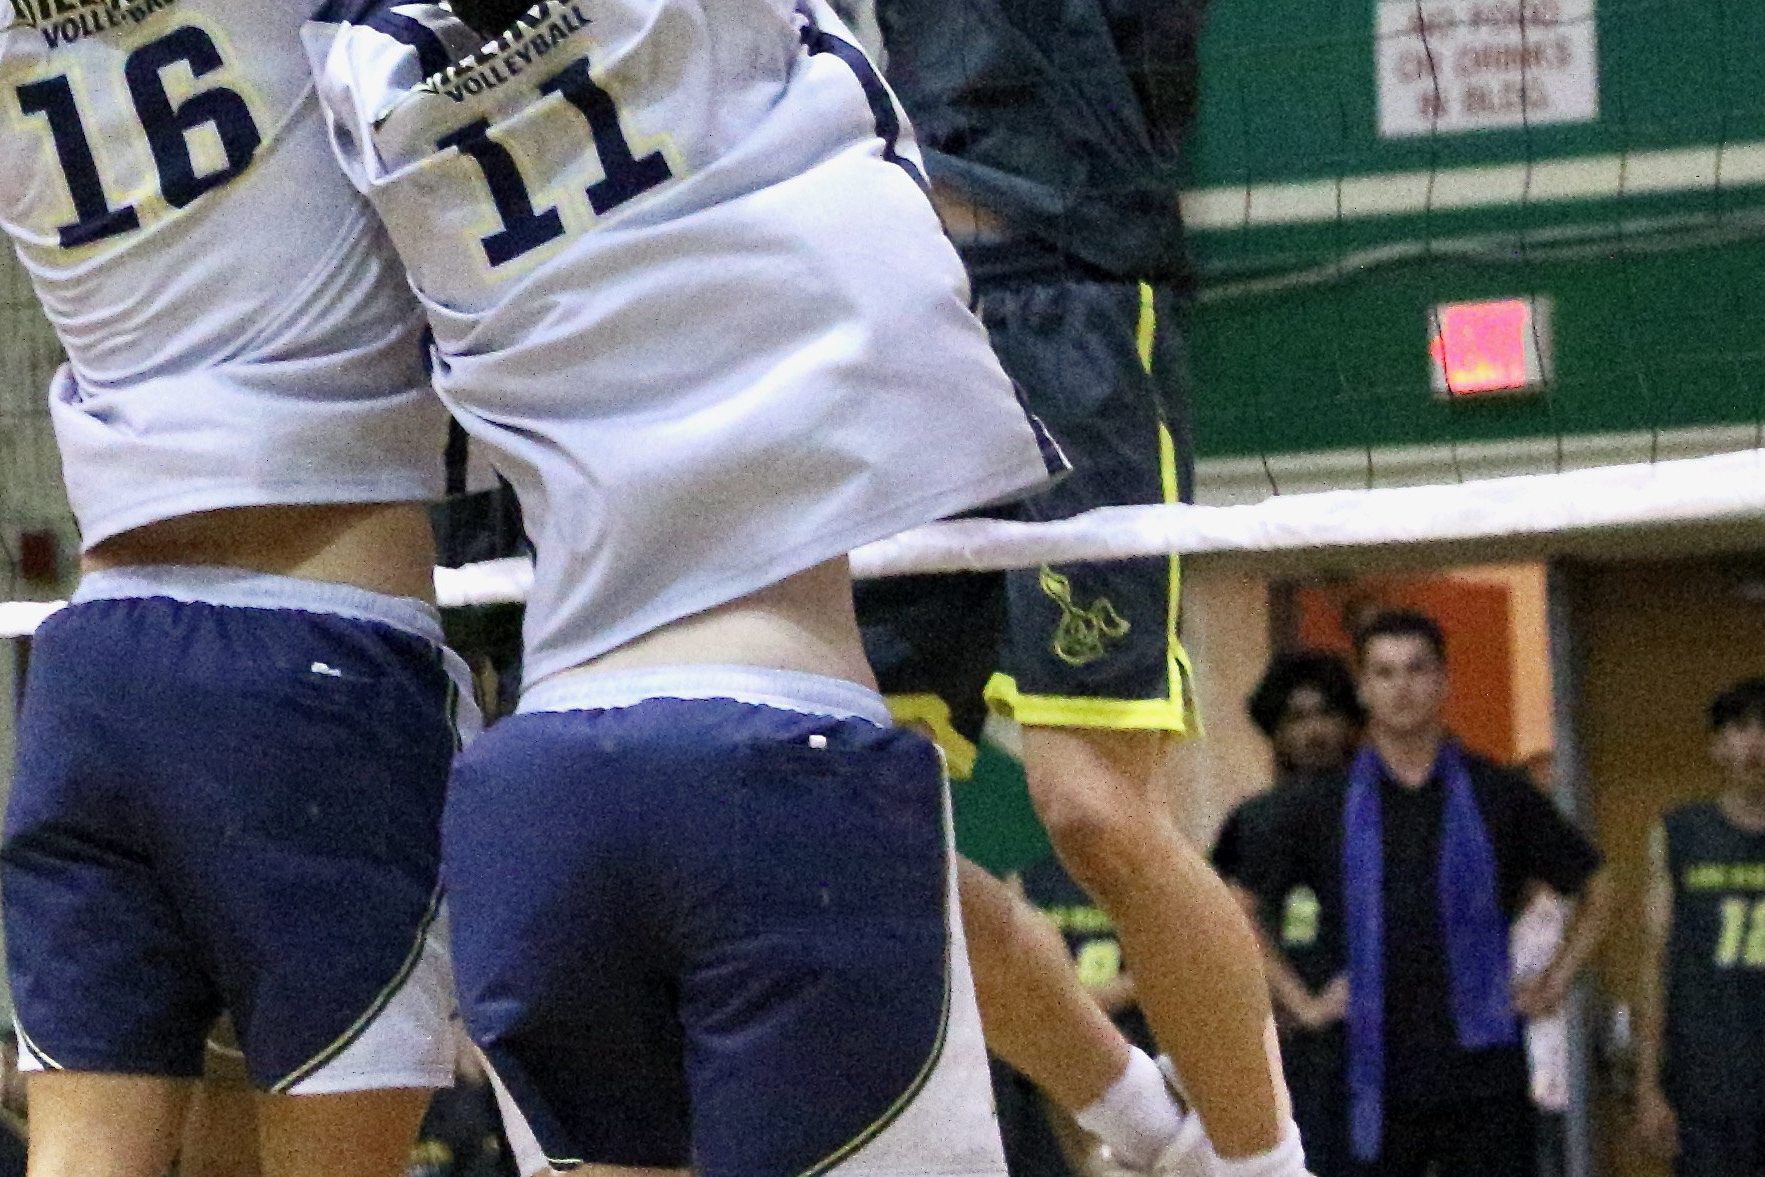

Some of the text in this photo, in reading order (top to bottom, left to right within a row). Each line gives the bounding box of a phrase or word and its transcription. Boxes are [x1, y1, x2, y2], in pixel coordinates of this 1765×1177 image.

[14, 25, 262, 248] 16
[435, 53, 673, 268] 11
[443, 5, 593, 104] VOLLEYBALL
